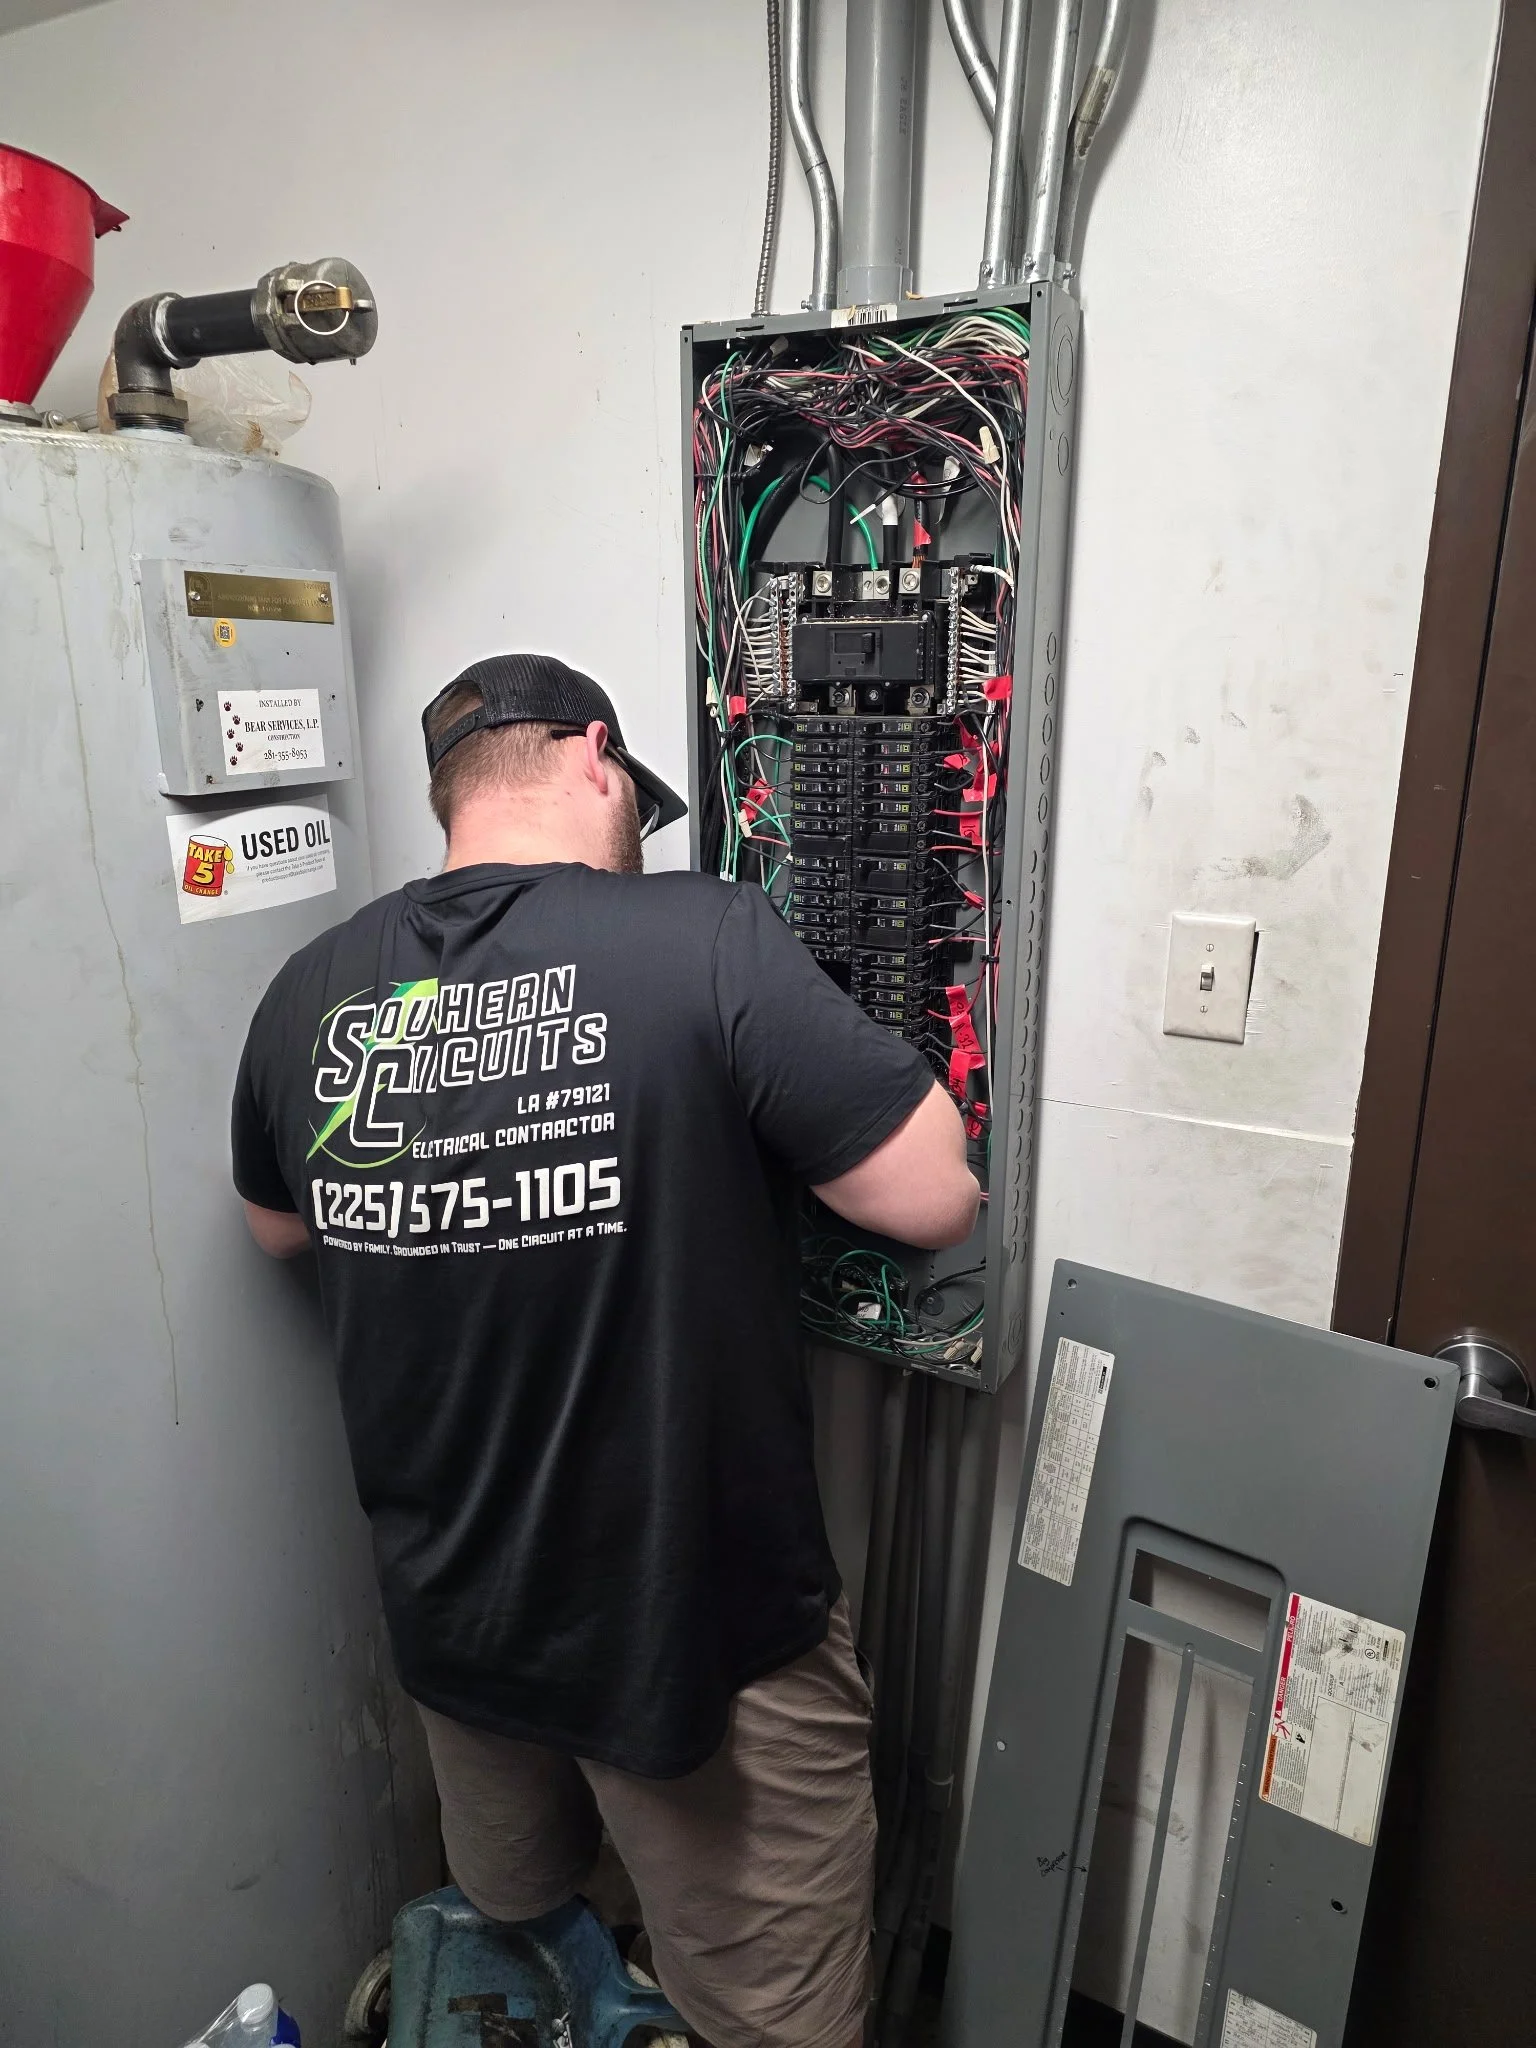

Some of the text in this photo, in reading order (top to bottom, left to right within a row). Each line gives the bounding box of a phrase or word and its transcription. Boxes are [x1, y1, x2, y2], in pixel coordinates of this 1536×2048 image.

[258, 698, 302, 708] INSTALLED BY
[244, 718, 320, 733] BEAR SERVICES, L.P.
[267, 733, 301, 742] CONSTRUCTION
[263, 747, 308, 762] 281-355-8953
[189, 843, 224, 863] TAKE
[240, 819, 331, 861] USED OIL
[192, 861, 215, 886] 5
[184, 884, 220, 896] OIL CHANGE
[315, 964, 577, 1103] SOUHERN
[517, 1082, 611, 1115] LA #79121
[494, 1112, 616, 1148] CONTRACTOR
[311, 1156, 621, 1239] (225) 575-1105
[322, 1234, 353, 1251] POWERED
[353, 1241, 364, 1252] BY
[393, 1242, 439, 1257] GROUNDED
[440, 1244, 450, 1255] IN
[450, 1239, 482, 1254] TRUST
[498, 1236, 519, 1252] ONE
[521, 1231, 565, 1249] CIRCUIT
[567, 1228, 583, 1243] AT
[585, 1226, 594, 1238] A
[596, 1221, 628, 1236] TIME.
[1278, 1676, 1287, 1703] DANGER
